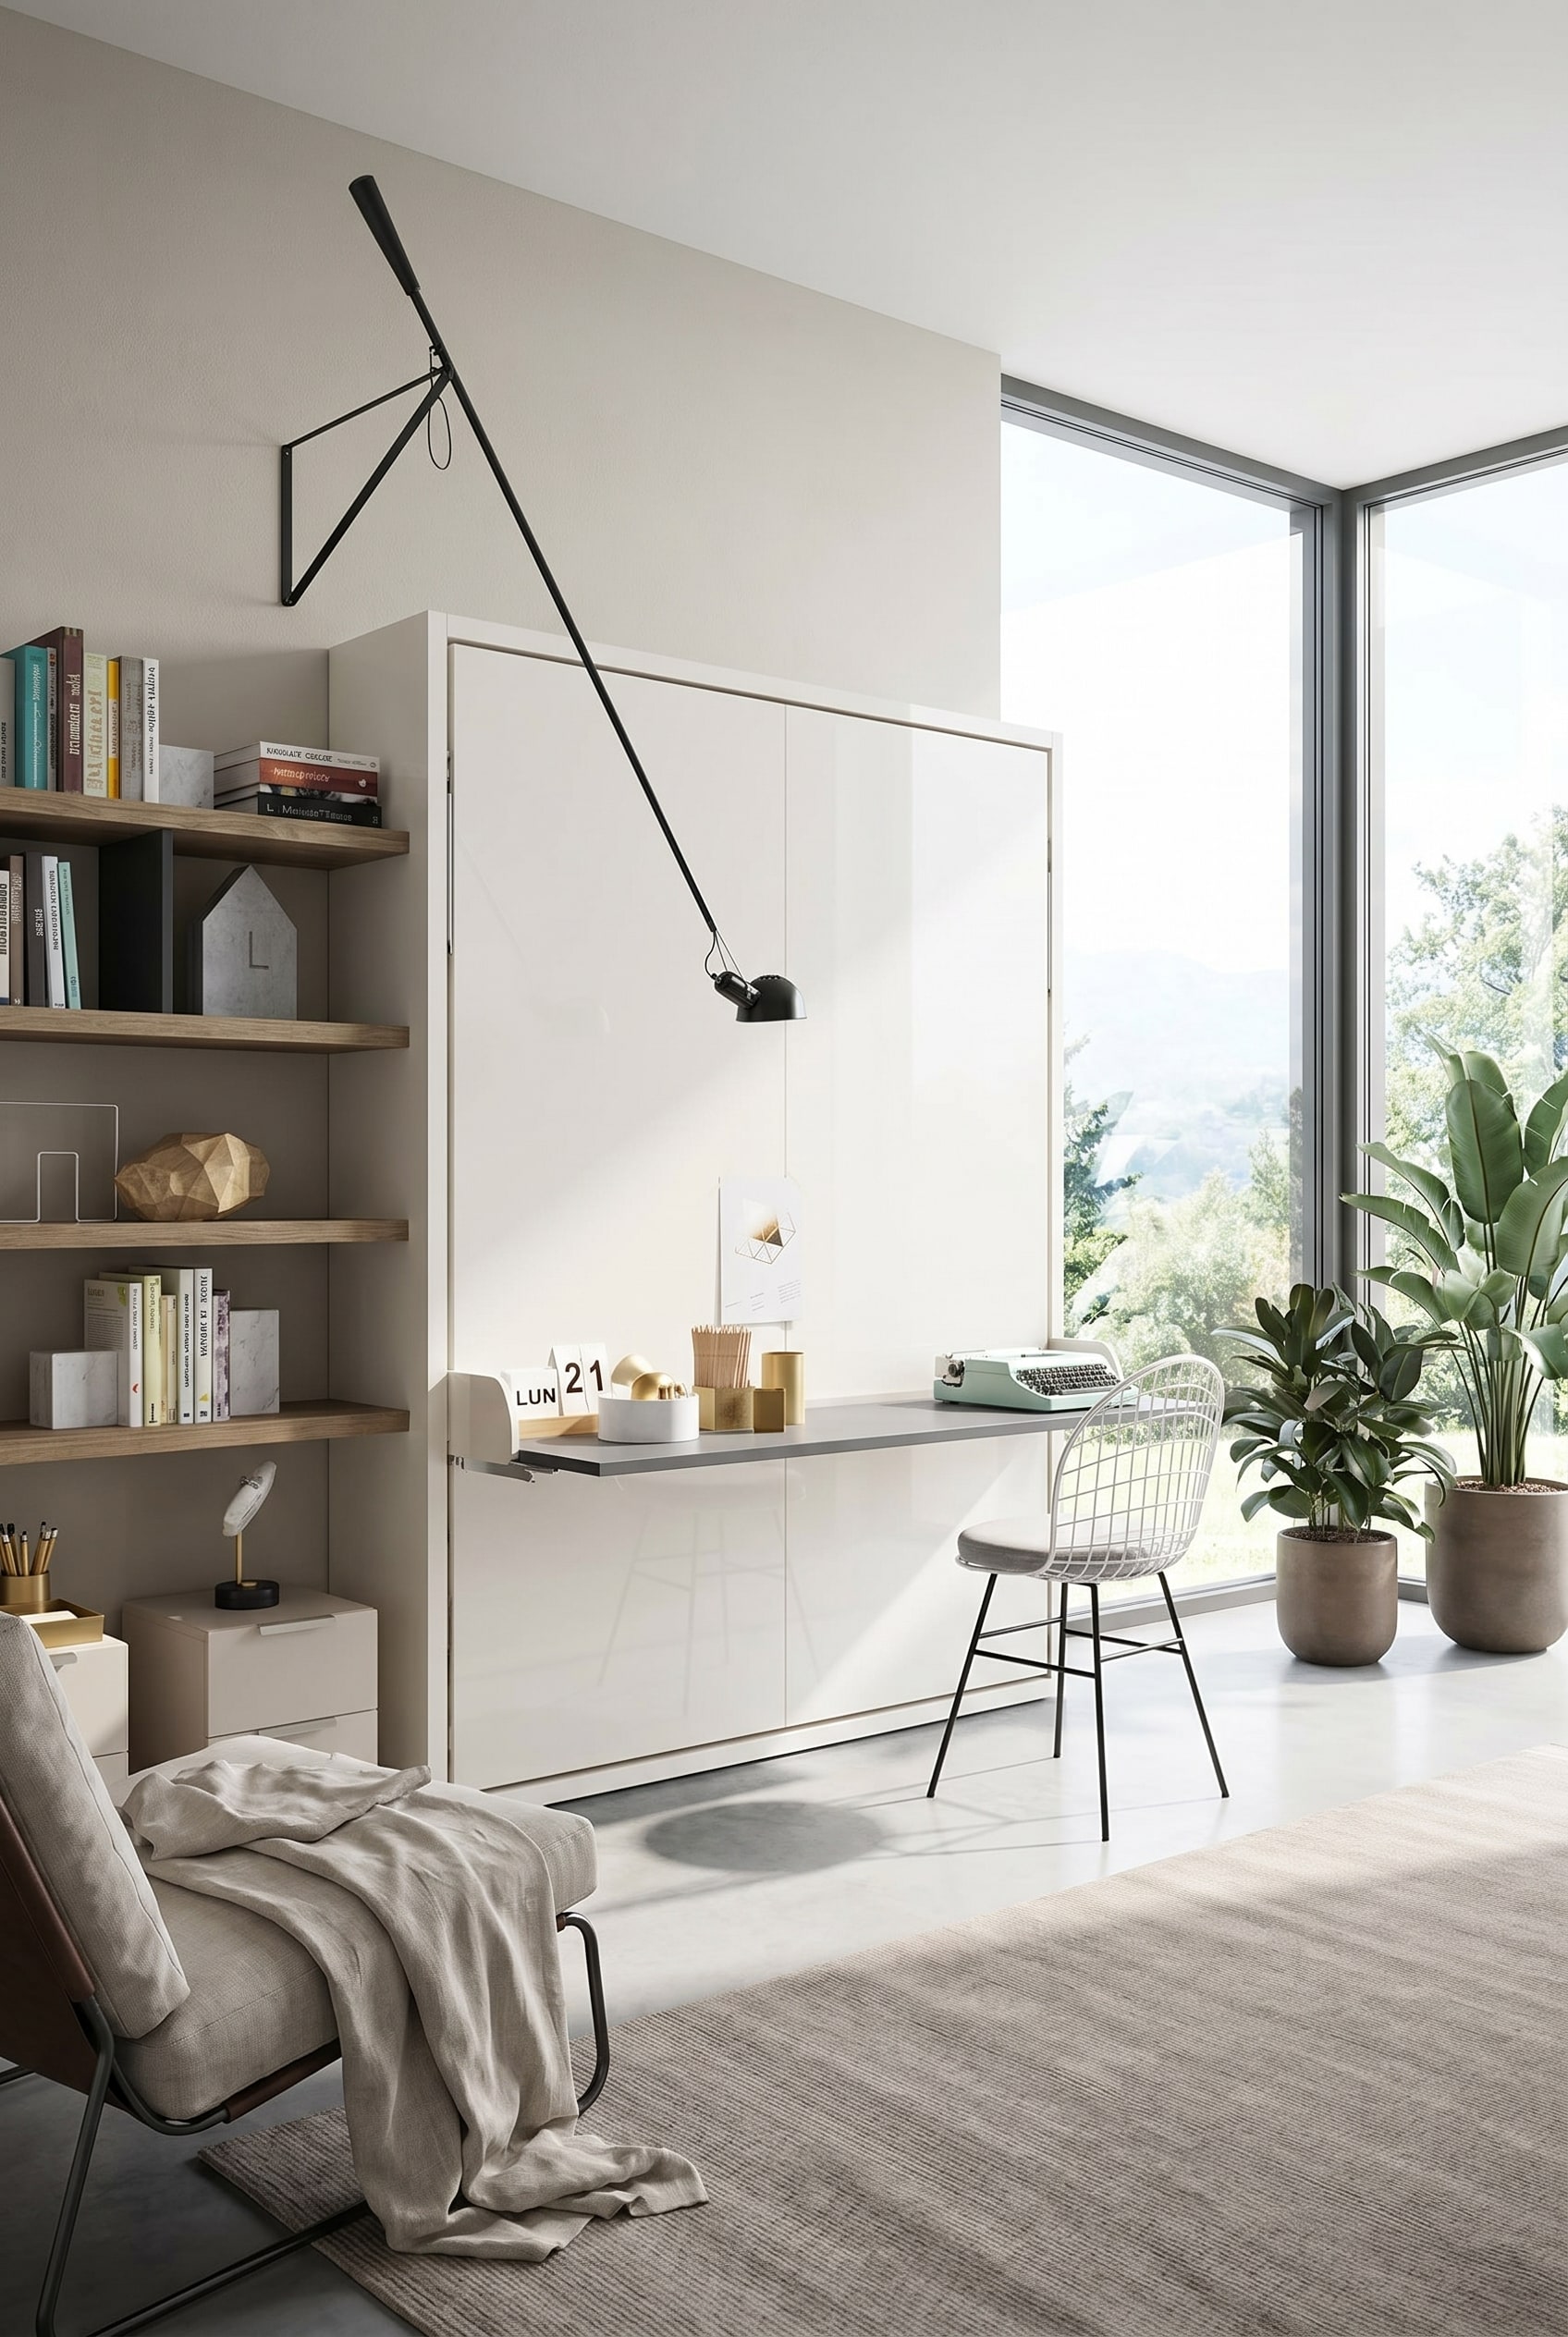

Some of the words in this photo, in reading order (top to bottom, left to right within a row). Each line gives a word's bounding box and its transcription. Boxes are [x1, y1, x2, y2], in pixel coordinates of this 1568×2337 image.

[249, 931, 269, 970] L
[517, 1388, 556, 1406] LUN
[565, 1359, 604, 1394] 21
